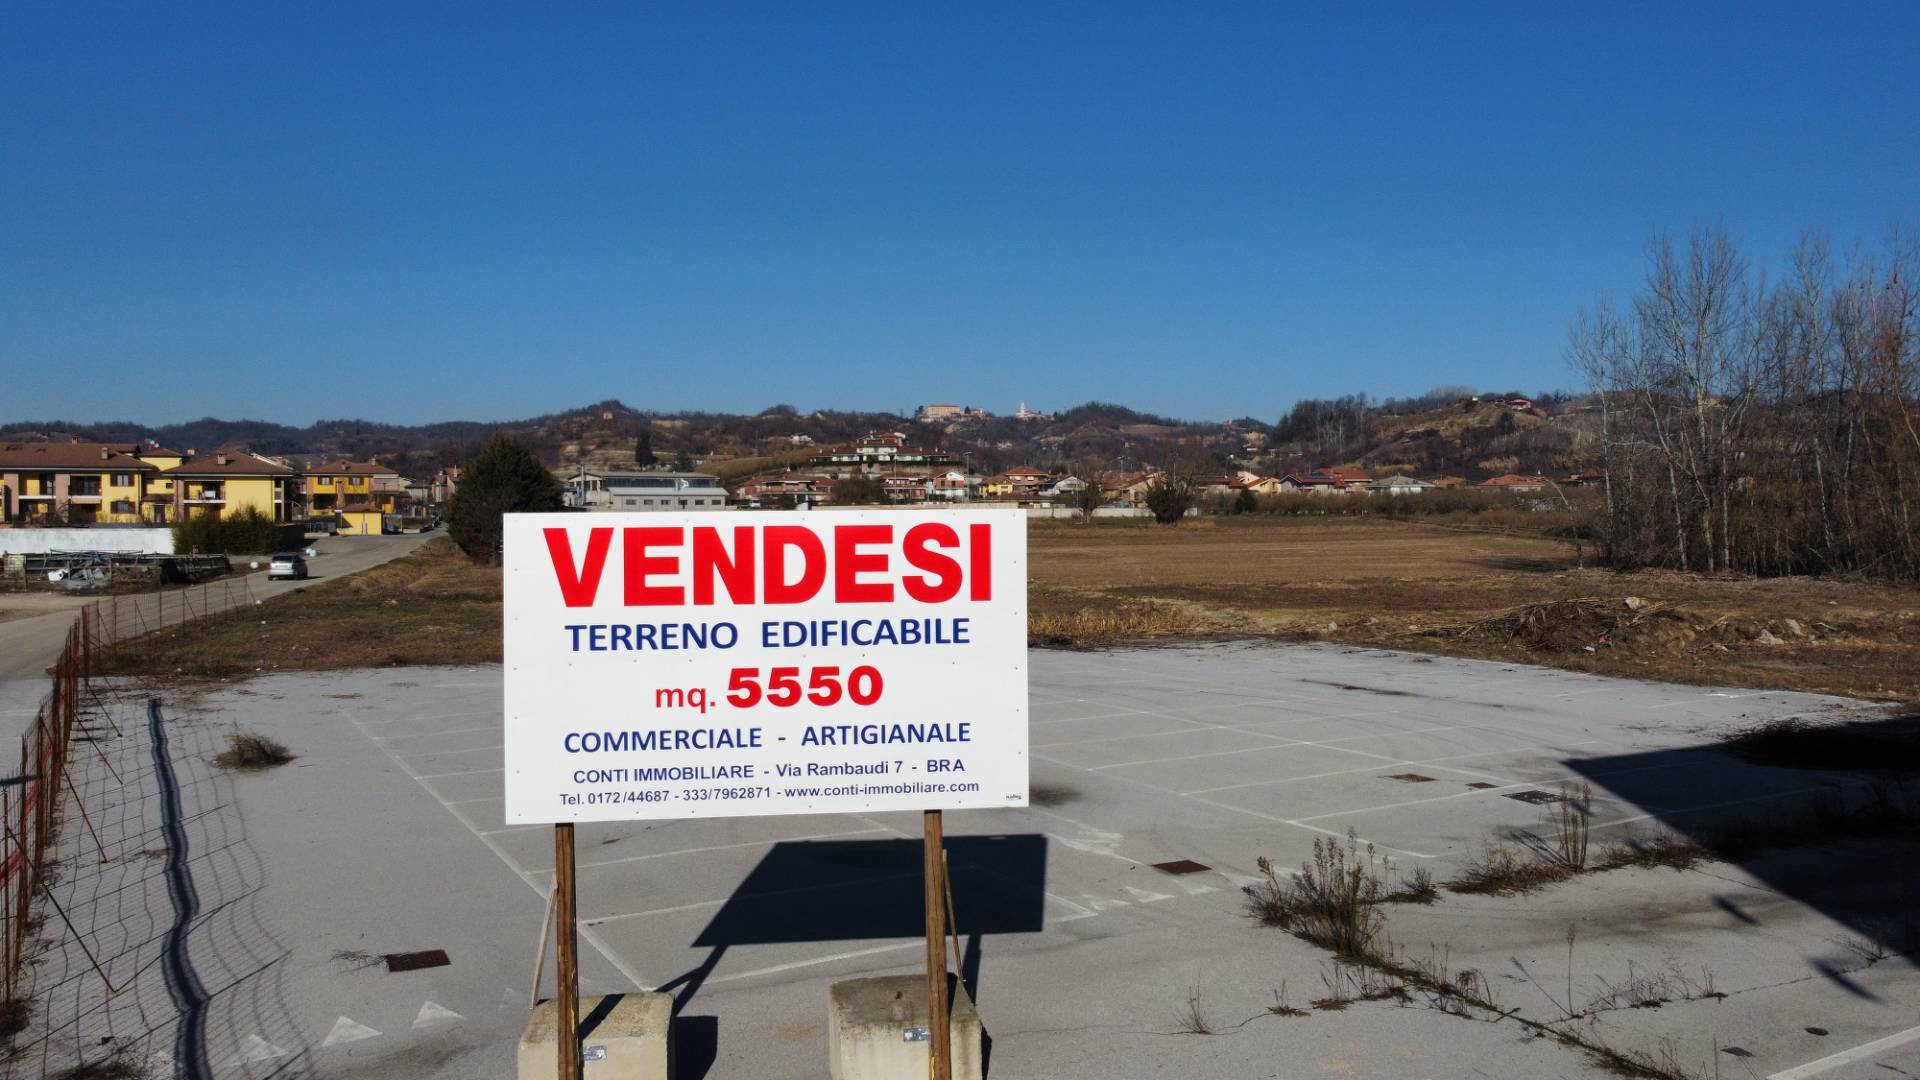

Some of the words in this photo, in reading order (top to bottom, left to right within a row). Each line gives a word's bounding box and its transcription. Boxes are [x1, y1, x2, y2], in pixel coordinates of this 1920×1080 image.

[543, 523, 991, 607] VENDESI
[565, 622, 738, 651] TERRENO
[761, 617, 970, 648] EDIFICABILE
[656, 688, 715, 713] mq.
[727, 665, 884, 708] 5550
[564, 728, 762, 753] COMMERCIALE
[801, 722, 971, 746] ARTIGIANALE
[573, 769, 628, 783] CONTI
[634, 765, 754, 782] IMMOBILIARE
[776, 763, 802, 777] Via
[807, 761, 889, 776] Rambaudi
[894, 760, 903, 774] 7
[926, 758, 965, 773] BRA
[560, 793, 585, 805] Tel.
[587, 790, 670, 805] 0172/44687
[683, 786, 770, 801] 333/7962871
[784, 783, 979, 798] www.conti-immobiliare.com
